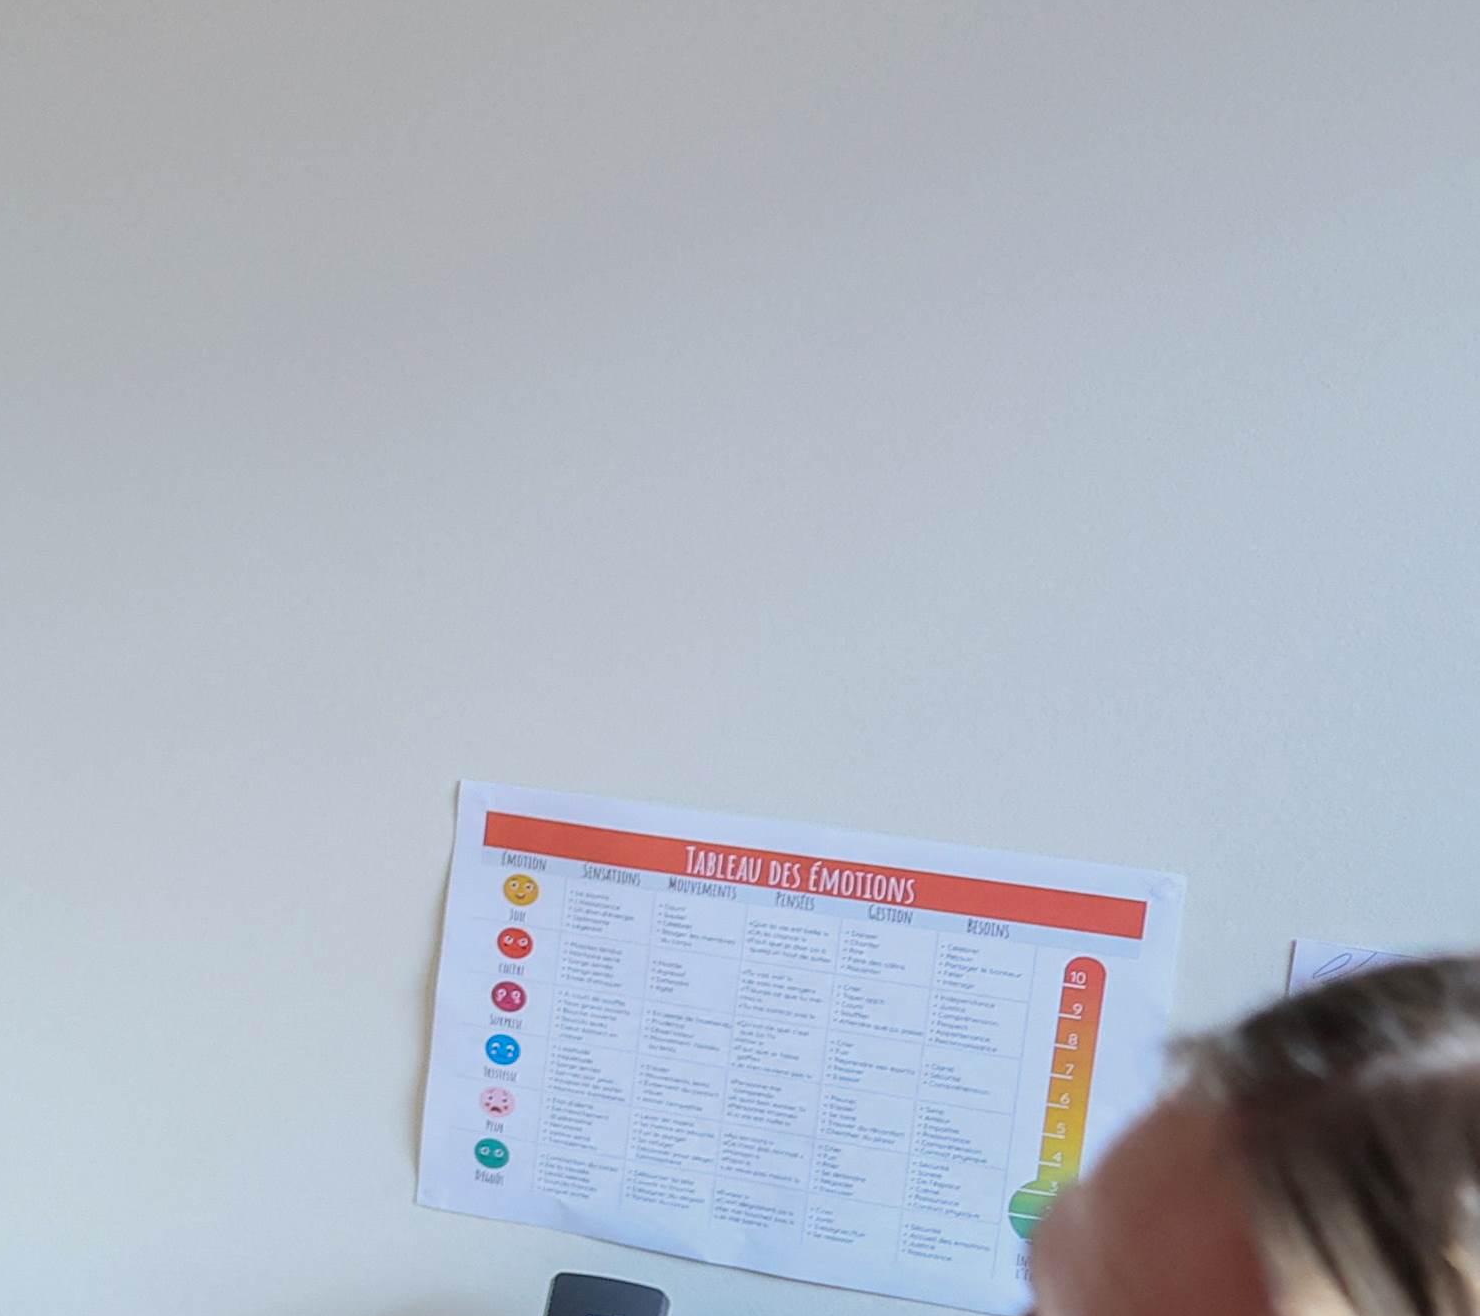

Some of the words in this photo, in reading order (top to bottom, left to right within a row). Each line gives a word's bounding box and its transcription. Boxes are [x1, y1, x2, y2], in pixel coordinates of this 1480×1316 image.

[683, 843, 765, 885] TABLEAU
[766, 856, 803, 890] DES
[806, 859, 918, 906] ÉMOTIONS
[866, 904, 913, 925] GESTION
[965, 917, 1011, 939] BESOINS
[1068, 969, 1087, 986] 10
[1071, 1003, 1083, 1017] 9
[1064, 1062, 1075, 1076] 7
[1059, 1092, 1071, 1106] 6
[1055, 1122, 1066, 1135] 5
[1051, 1150, 1062, 1164] 4
